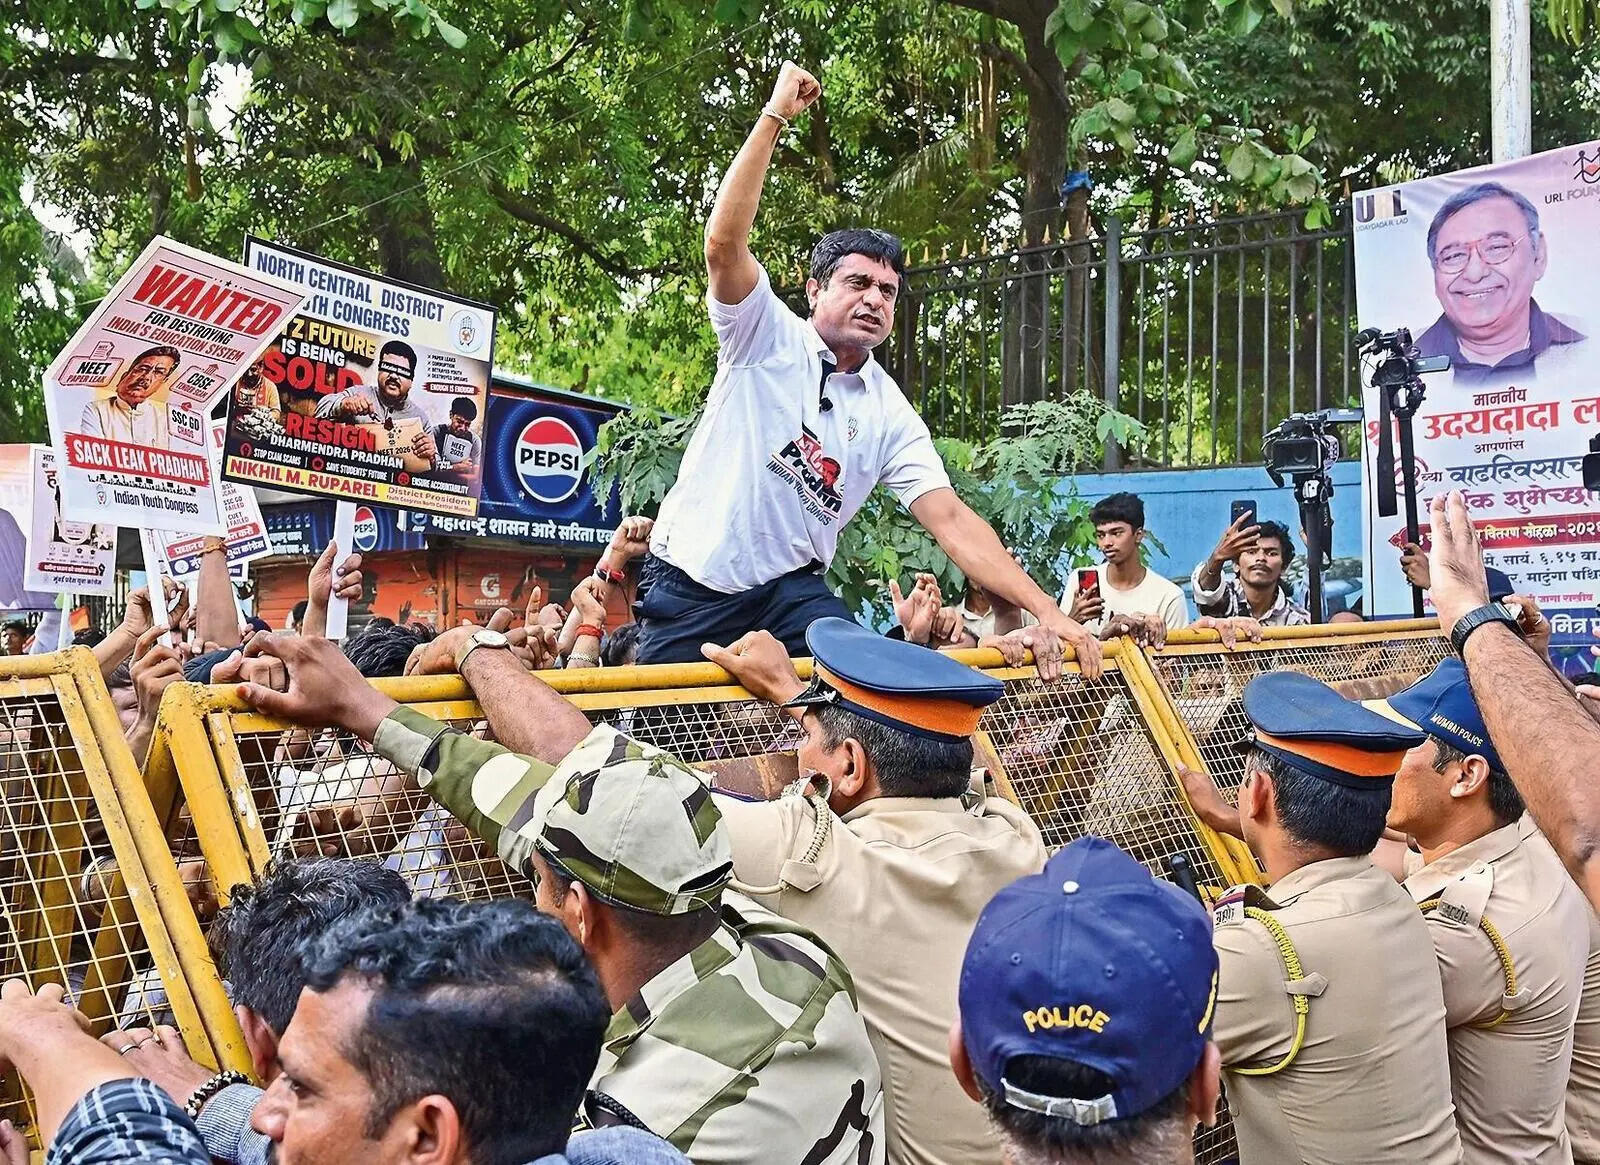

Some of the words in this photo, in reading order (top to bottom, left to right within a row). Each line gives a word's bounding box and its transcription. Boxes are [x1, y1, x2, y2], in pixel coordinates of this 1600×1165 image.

[1544, 193, 1564, 205] URL
[256, 251, 305, 284] NORTH
[308, 267, 372, 304] CENTRAL
[381, 288, 445, 322] DISTRICT
[131, 264, 283, 335] WANTED
[143, 311, 169, 328] FOR
[167, 318, 234, 345] DESTROYING
[332, 300, 410, 338] CONGRESS
[106, 315, 152, 337] INDIA'S
[149, 328, 208, 352] EDUCATION
[205, 343, 246, 362] SYSTEM
[293, 319, 304, 338] Z
[309, 322, 377, 359] FUTURE
[281, 338, 296, 355] IS
[299, 342, 345, 366] BEING
[66, 374, 90, 383] PAPER
[88, 375, 107, 384] LEAK
[76, 361, 112, 375] NEET
[263, 350, 364, 394] SOLD
[187, 373, 216, 390] CBSE
[429, 383, 449, 392] ENOUGH
[449, 385, 455, 393] IS
[1473, 386, 1528, 407] माननीय
[171, 409, 188, 427] SSC
[189, 416, 200, 431] GD
[1422, 402, 1560, 440] उदयदादा
[1571, 397, 1600, 425] ल
[286, 412, 377, 451] RESIGN
[270, 434, 349, 460] DHARMENDRA
[350, 450, 404, 470] PRADHAN
[396, 446, 411, 454] 2026
[450, 441, 467, 451] NEET
[1474, 437, 1525, 454] आपणांस
[73, 438, 116, 469] SACK
[114, 446, 147, 474] LEAK
[149, 452, 206, 482] PRADHAN
[253, 448, 268, 459] STOP
[267, 451, 283, 462] EXAM
[282, 454, 302, 466] SCAMS
[520, 447, 580, 472] PEPSI
[229, 458, 284, 483] NIKHIL
[285, 469, 305, 486] M.
[308, 474, 379, 498] RUPAREL
[326, 462, 340, 473] SAVE
[368, 469, 388, 481] FUTURE
[766, 460, 796, 486] INDIAN
[1445, 453, 1584, 487] वाढदिवसाच
[221, 483, 233, 491] BSE
[222, 488, 237, 497] CAM
[411, 476, 431, 488] ENSURE
[113, 489, 140, 506] Indian
[140, 493, 164, 509] Youth
[164, 496, 199, 515] Congress
[225, 502, 245, 512] FAILED
[388, 486, 424, 499] District
[425, 492, 471, 506] President
[230, 516, 250, 527] FAILED
[354, 524, 376, 534] PEPSI
[431, 514, 487, 537] महाराष्ट्र
[489, 518, 530, 537] शासन
[531, 519, 558, 540] आरे
[557, 521, 595, 543] सरिता
[1527, 568, 1568, 587] माटुंगा
[1571, 566, 1600, 581] पश्चि
[1550, 613, 1588, 635] मित्र
[1430, 712, 1461, 734] MUMBAI
[1458, 728, 1484, 747] POLICE
[1022, 1004, 1111, 1034] POLICE
